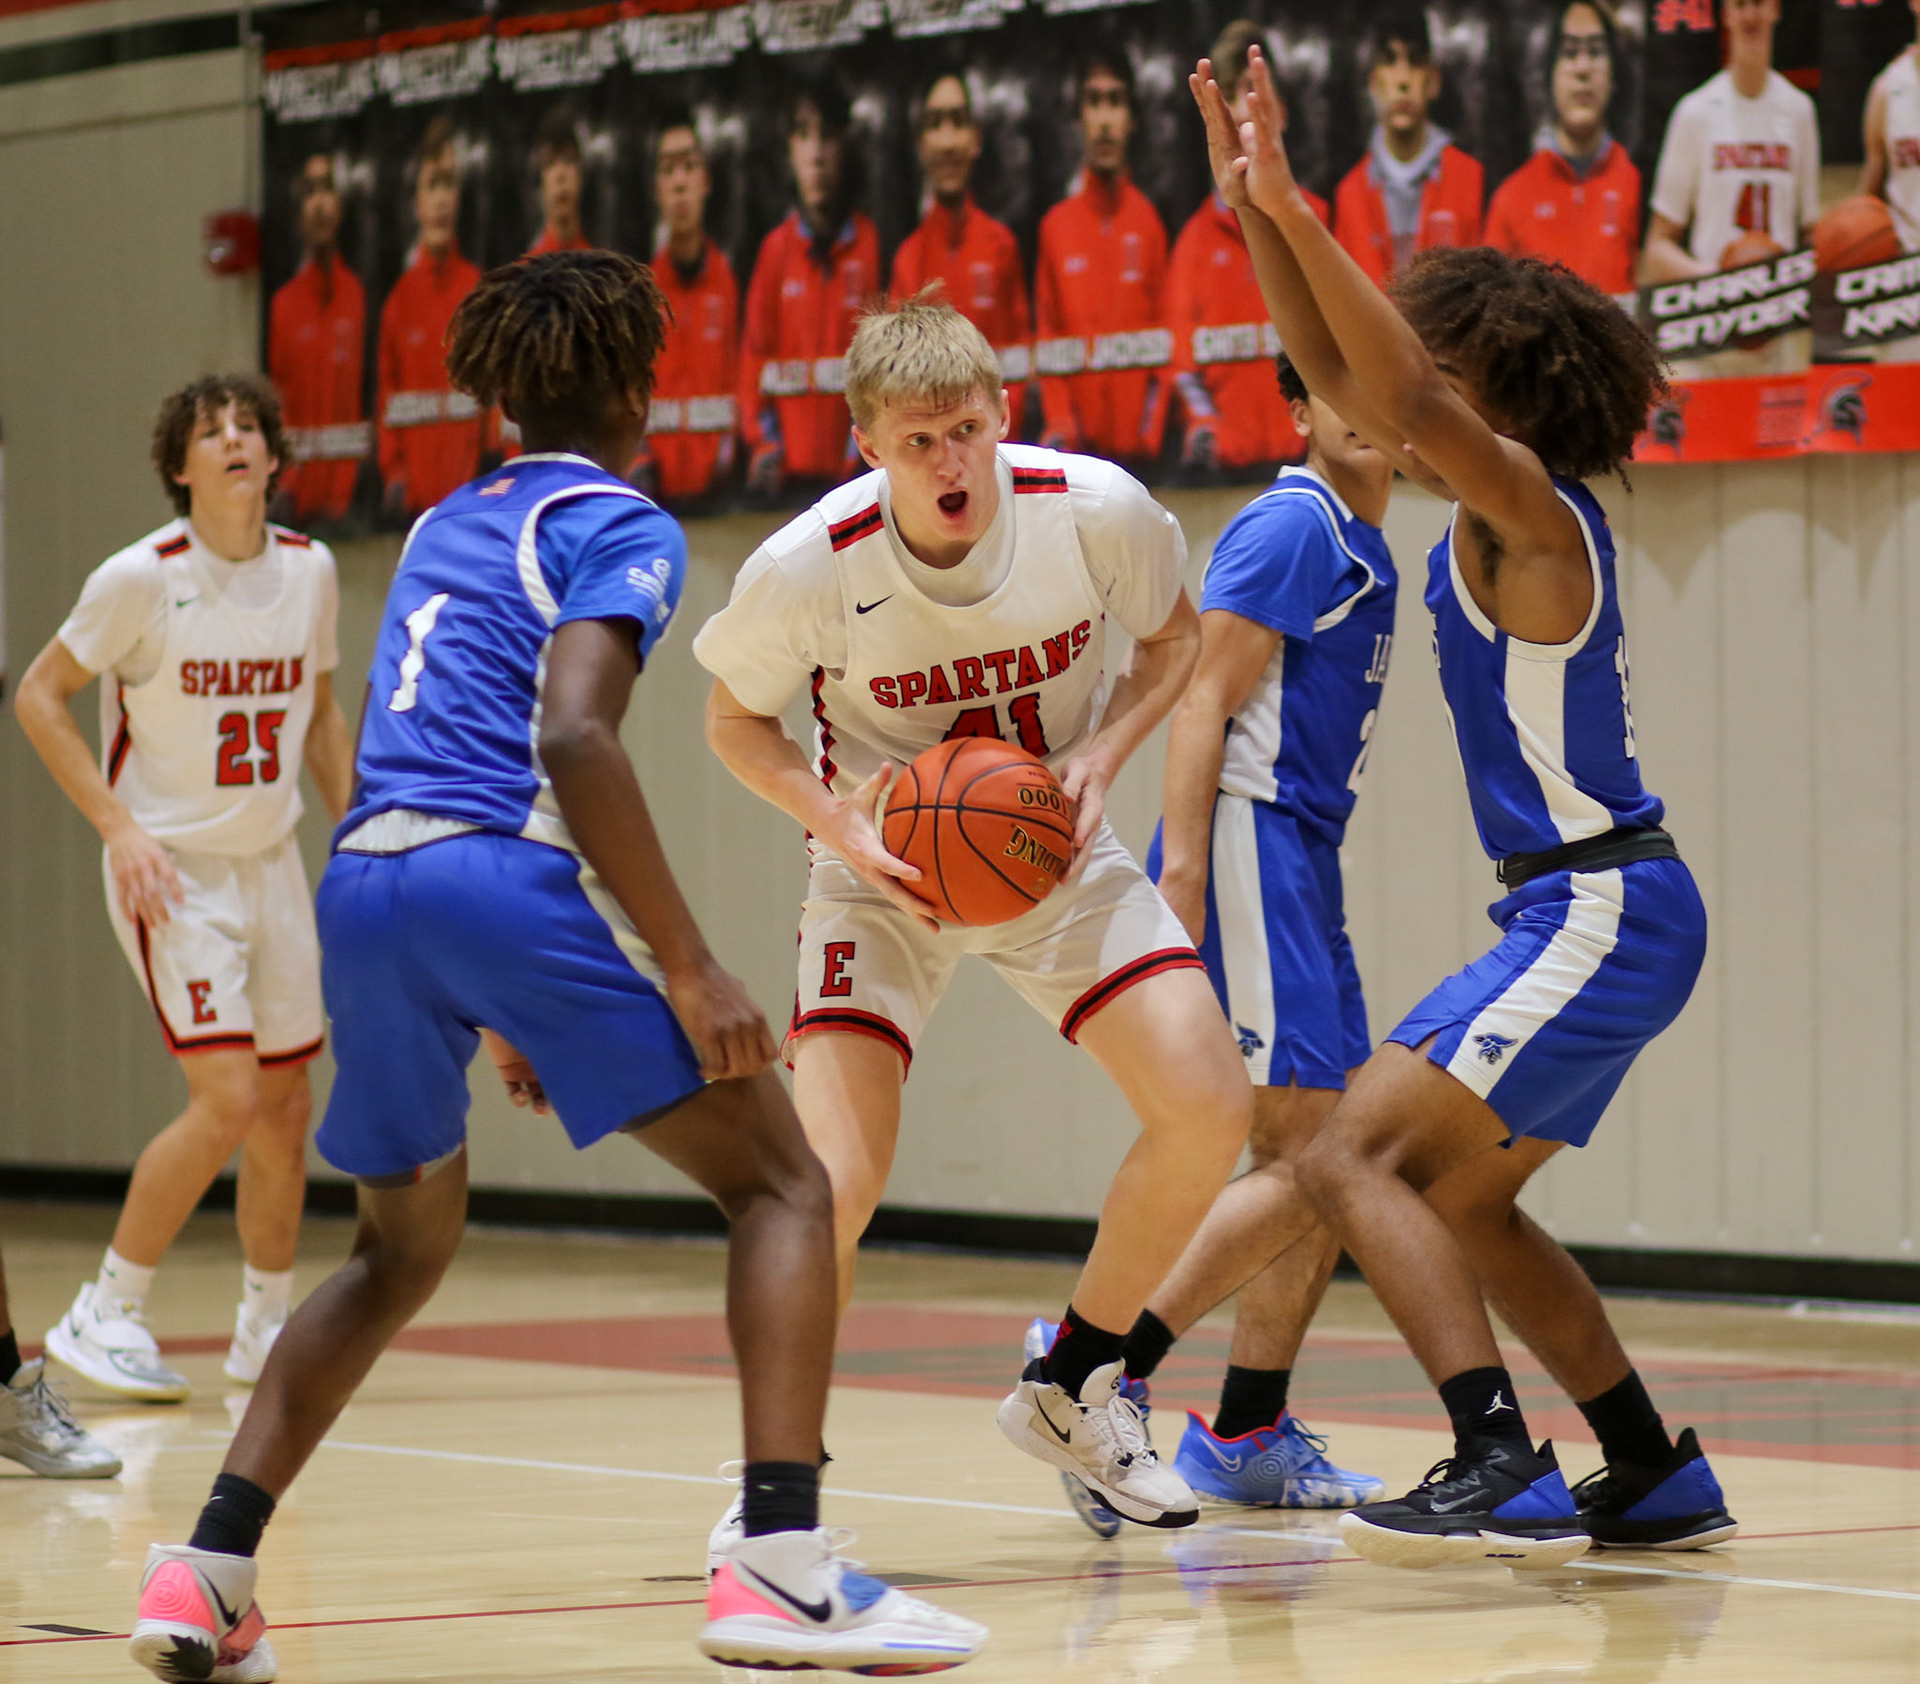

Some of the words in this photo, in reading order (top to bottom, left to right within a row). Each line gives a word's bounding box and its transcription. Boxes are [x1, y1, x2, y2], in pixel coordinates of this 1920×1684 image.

[1652, 250, 1817, 317] CHARLES
[1658, 288, 1811, 350] SNYDER
[386, 592, 450, 713] 1
[869, 619, 1091, 709] SPARTANS
[216, 708, 288, 786] 25
[186, 979, 217, 1025] E
[820, 941, 856, 998] E
